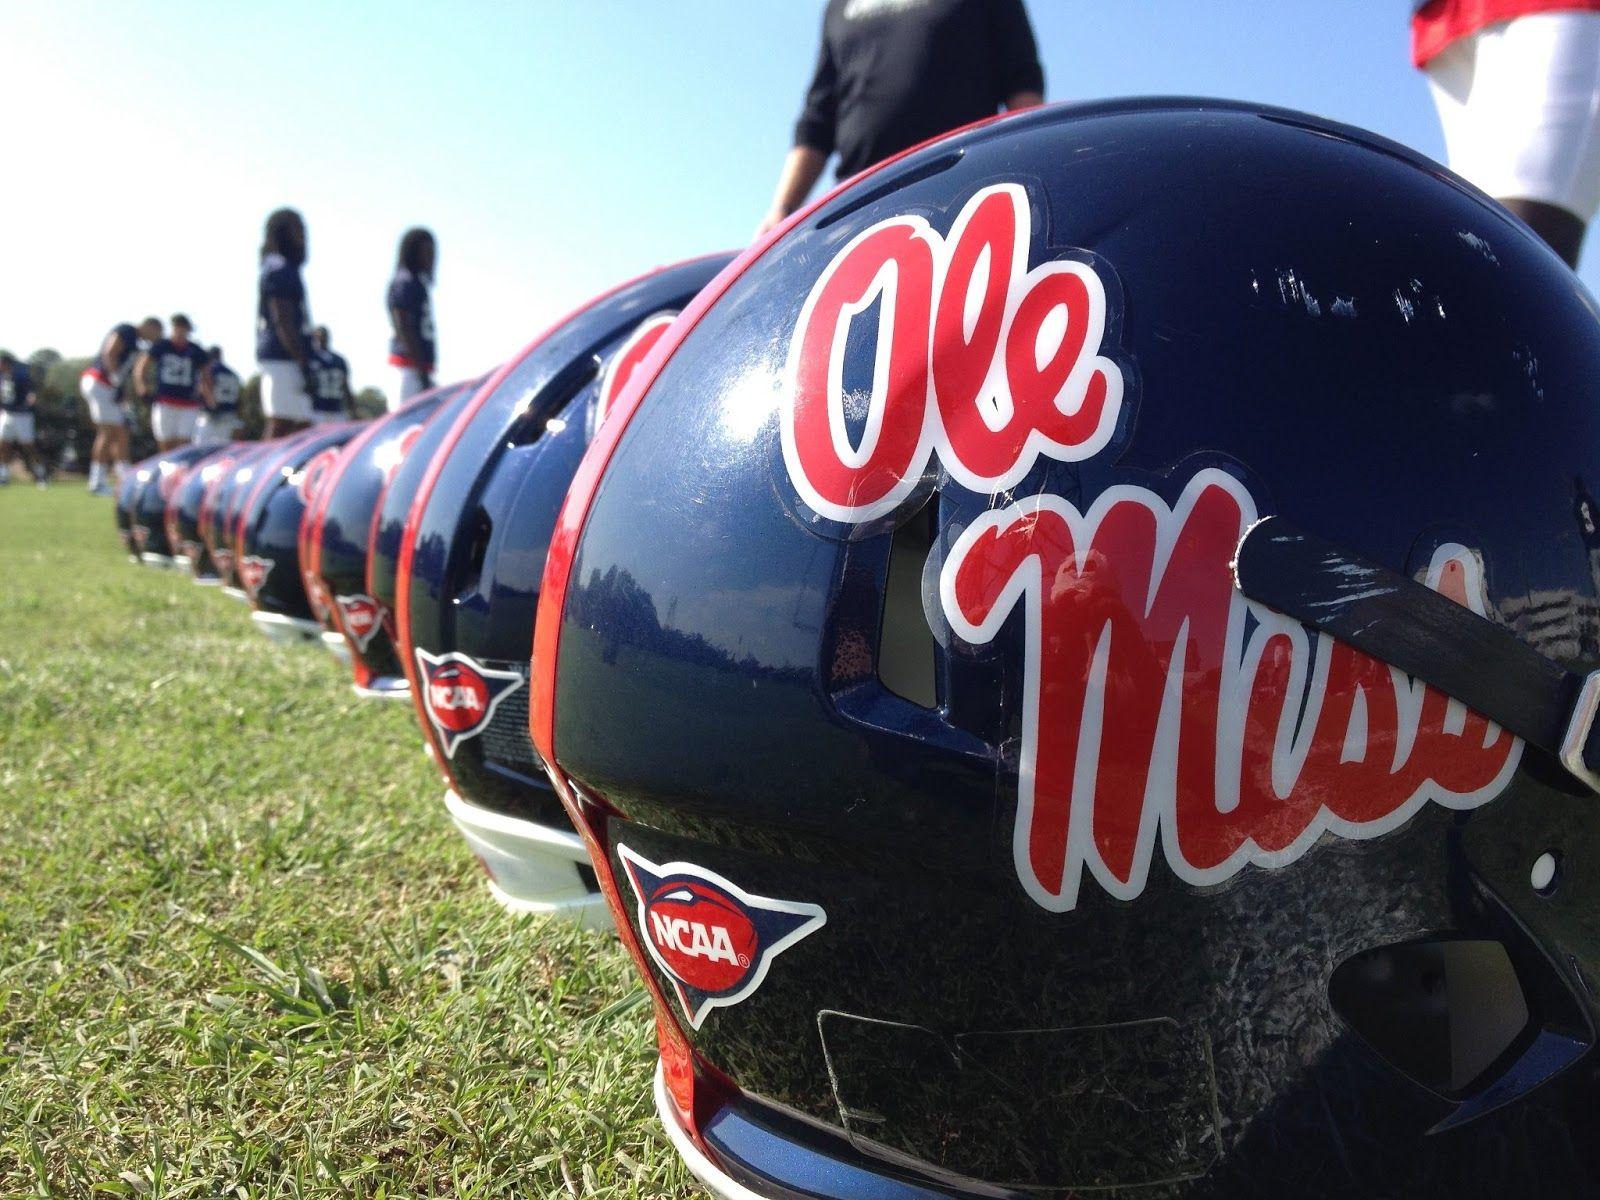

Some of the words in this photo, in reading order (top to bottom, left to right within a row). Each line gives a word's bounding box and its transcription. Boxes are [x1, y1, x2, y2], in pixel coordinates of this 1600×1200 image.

[780, 183, 1124, 524] Ole
[430, 684, 485, 711] NCAA
[650, 911, 740, 967] NCAA
